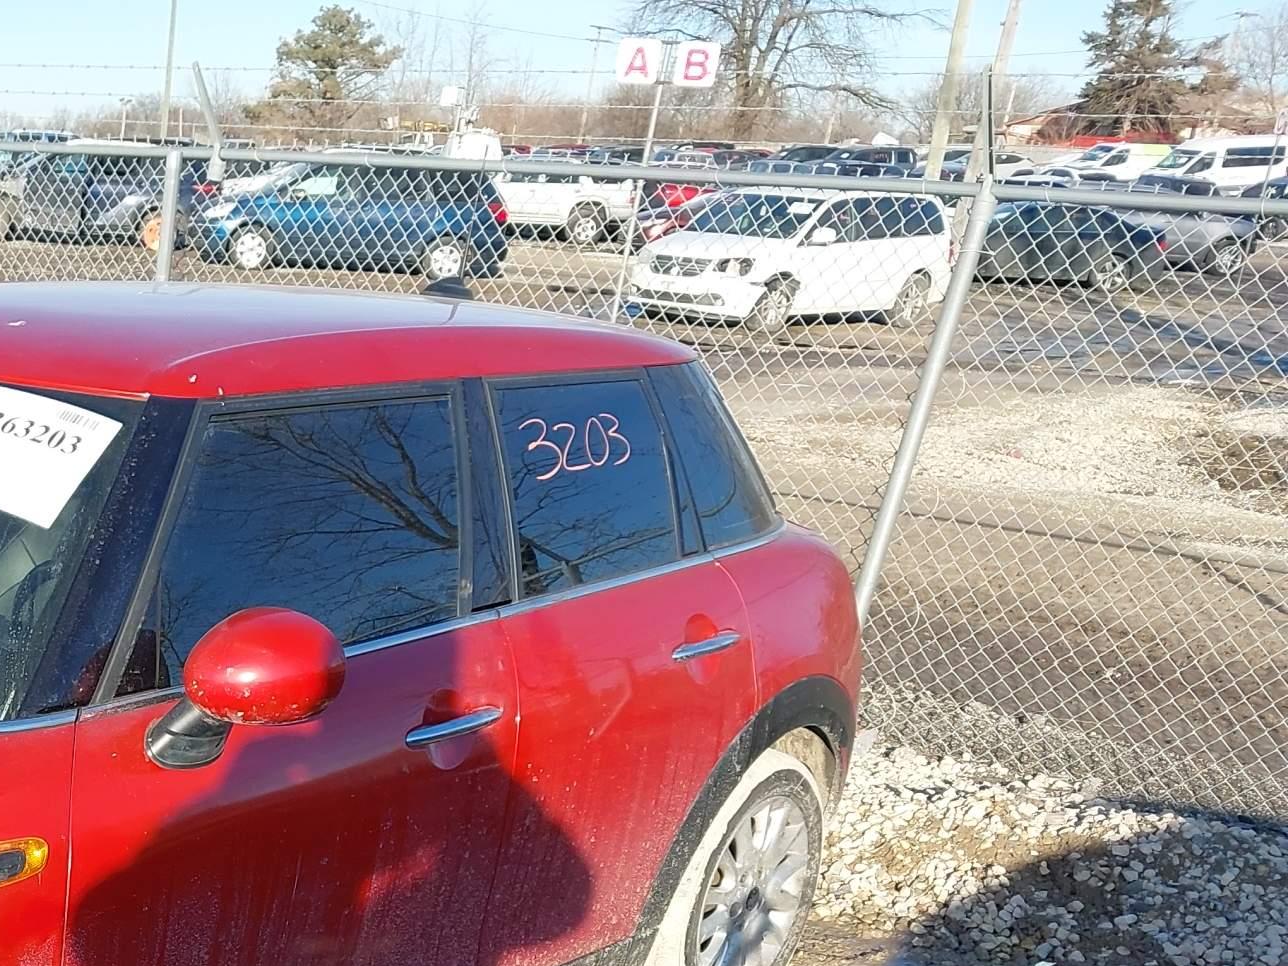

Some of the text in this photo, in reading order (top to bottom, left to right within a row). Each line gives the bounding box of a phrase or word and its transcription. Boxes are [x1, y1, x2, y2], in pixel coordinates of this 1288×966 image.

[624, 47, 649, 78] A
[684, 49, 710, 80] B
[518, 413, 631, 481] 3203
